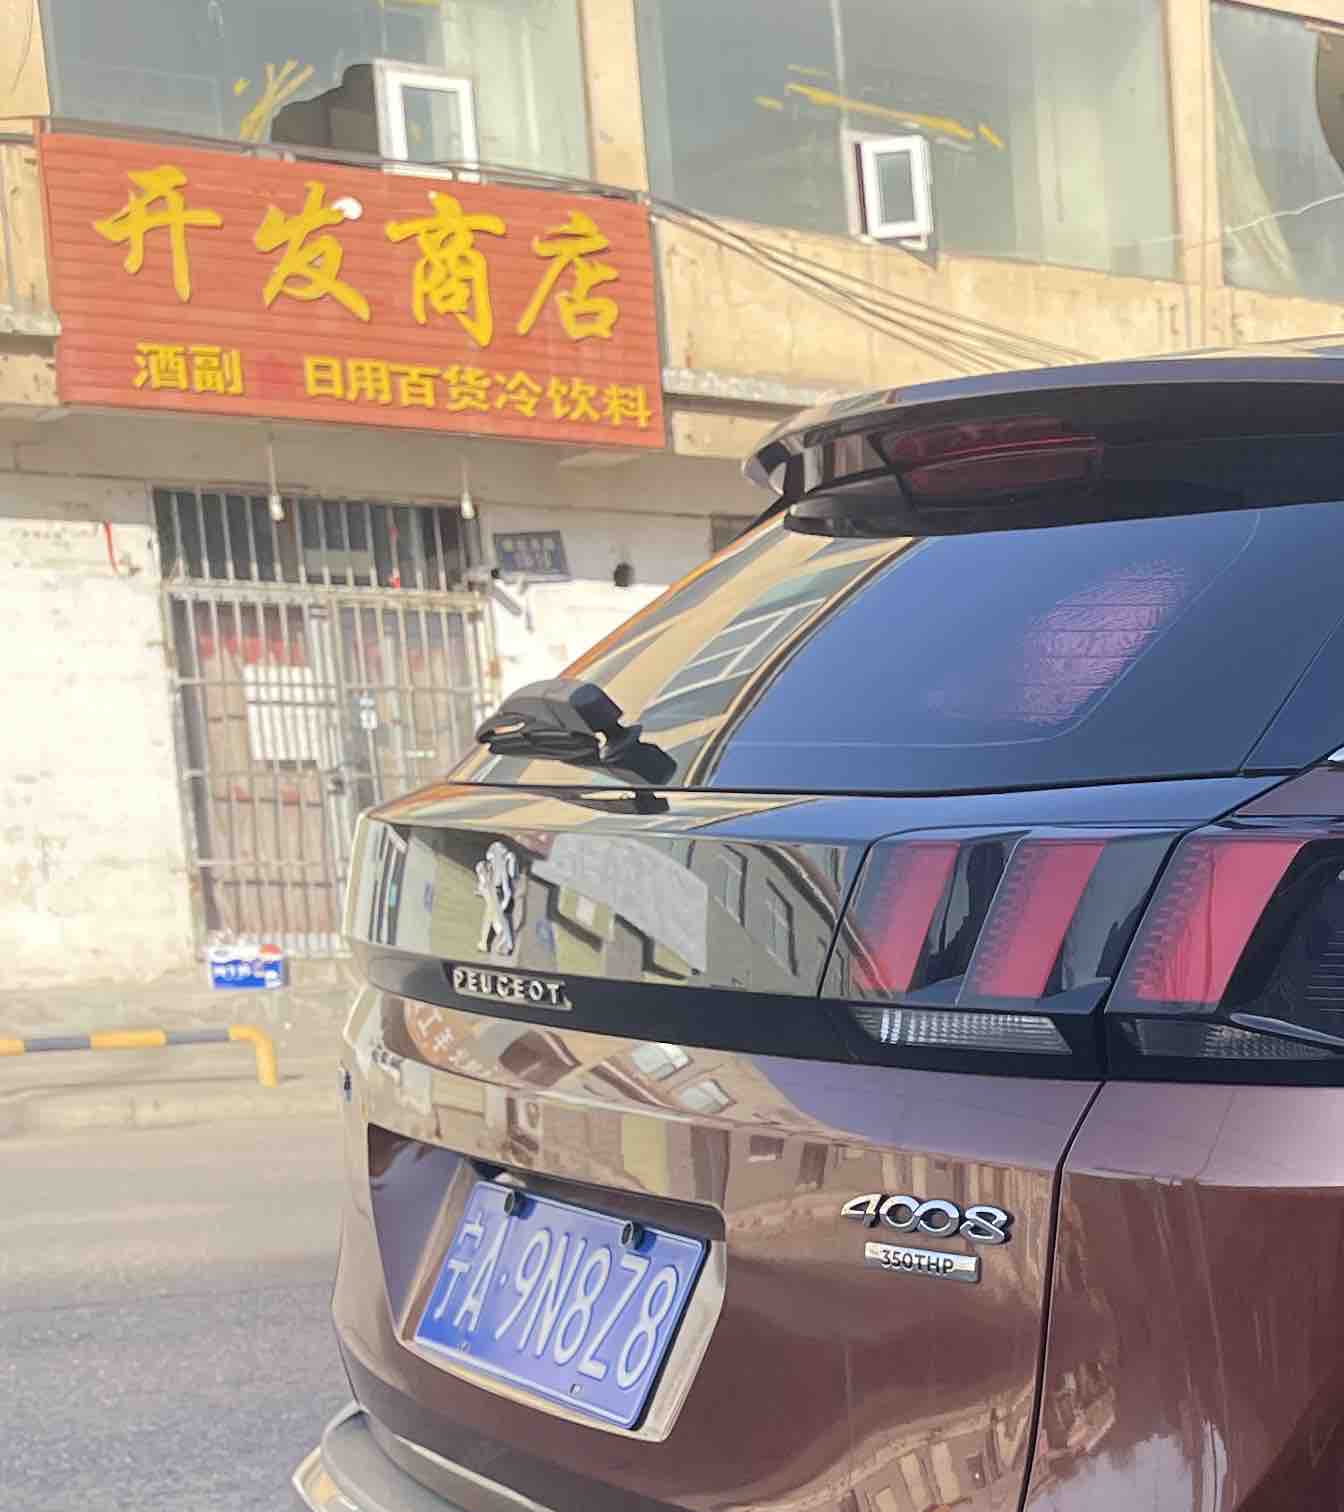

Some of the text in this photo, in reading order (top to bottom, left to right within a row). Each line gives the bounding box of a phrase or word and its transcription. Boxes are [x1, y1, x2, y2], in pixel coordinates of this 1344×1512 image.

[93, 164, 621, 348] 开发商店
[303, 355, 652, 428] 日用百货冷饮料
[452, 967, 561, 1004] PEUGEOT
[840, 1193, 1009, 1244] 4008
[880, 1248, 955, 1276] 350THP
